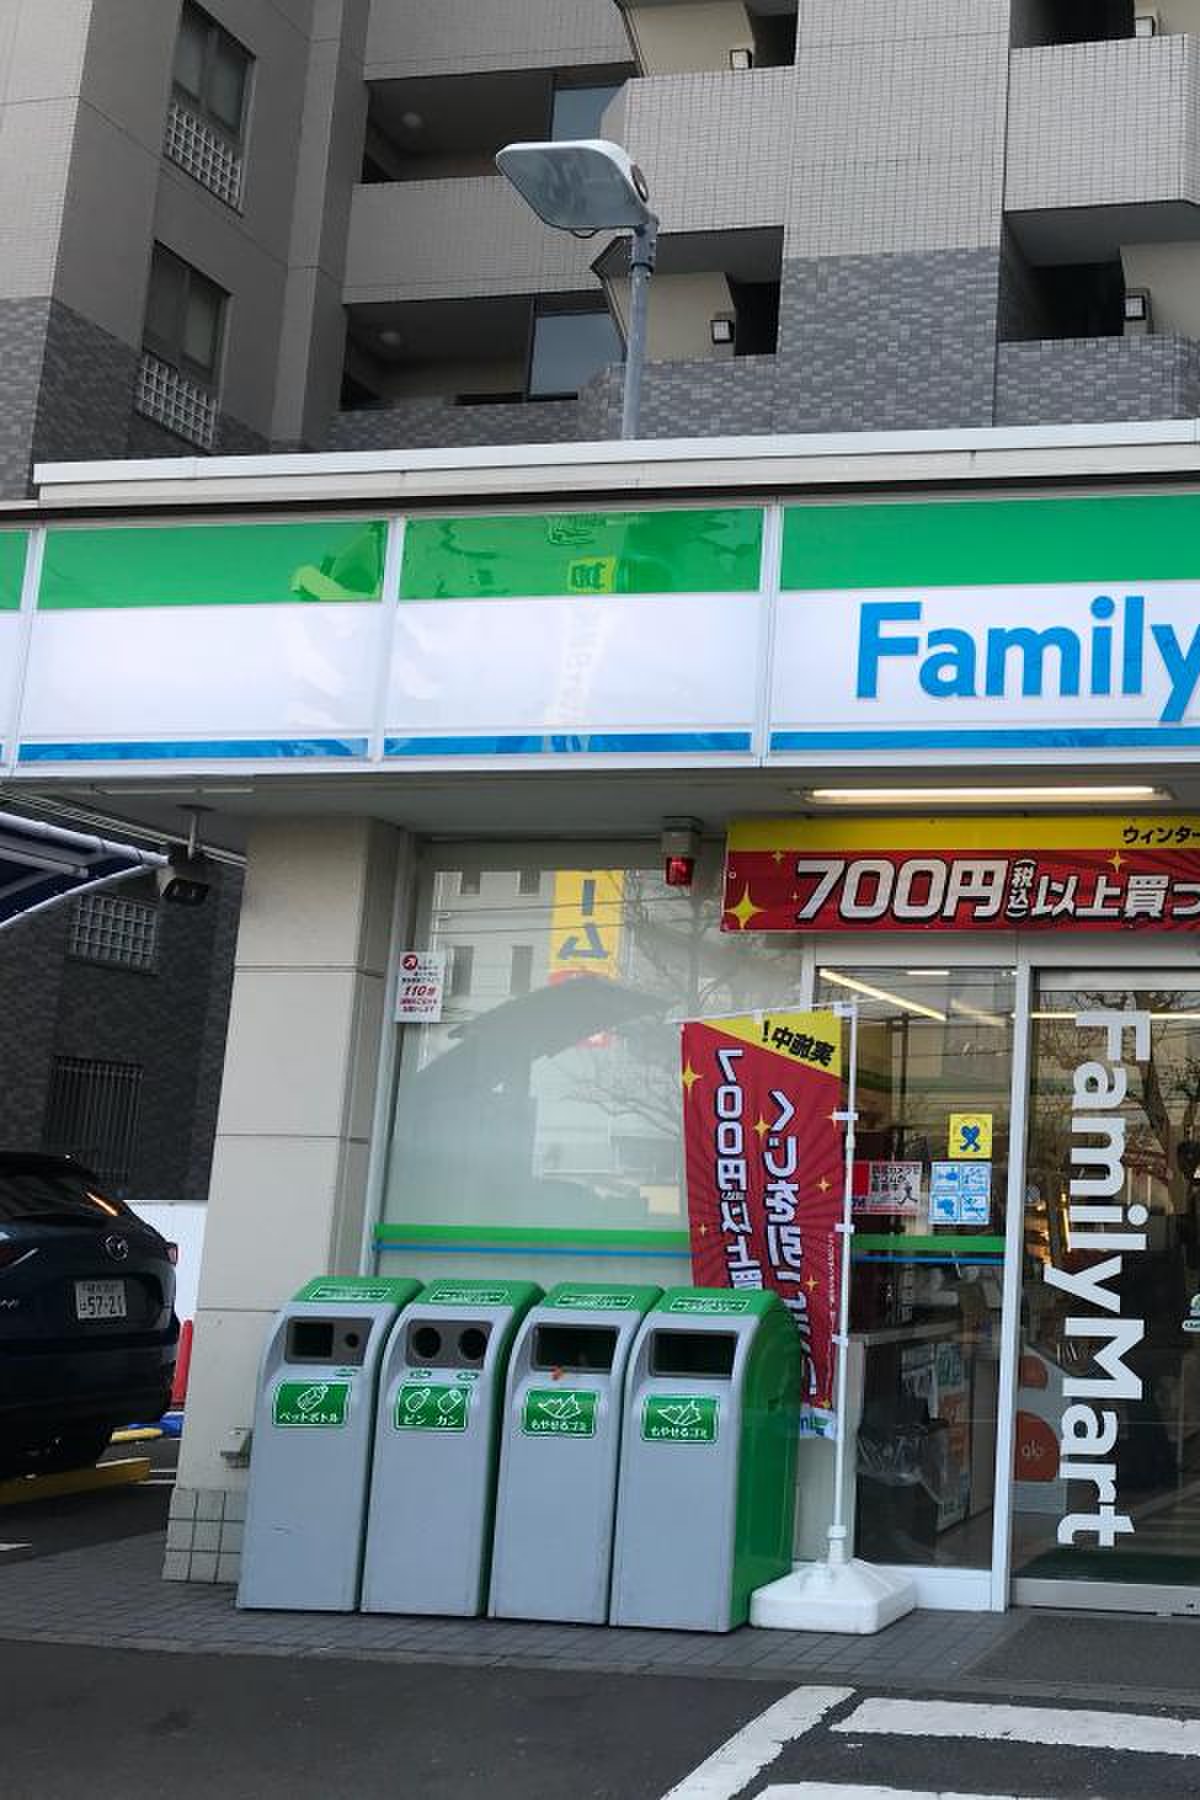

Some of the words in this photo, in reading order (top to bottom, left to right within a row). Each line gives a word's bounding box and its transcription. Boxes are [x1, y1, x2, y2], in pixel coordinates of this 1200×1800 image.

[1043, 1010, 1151, 1548] FamilyMart
[279, 1413, 339, 1424] ペットボトル
